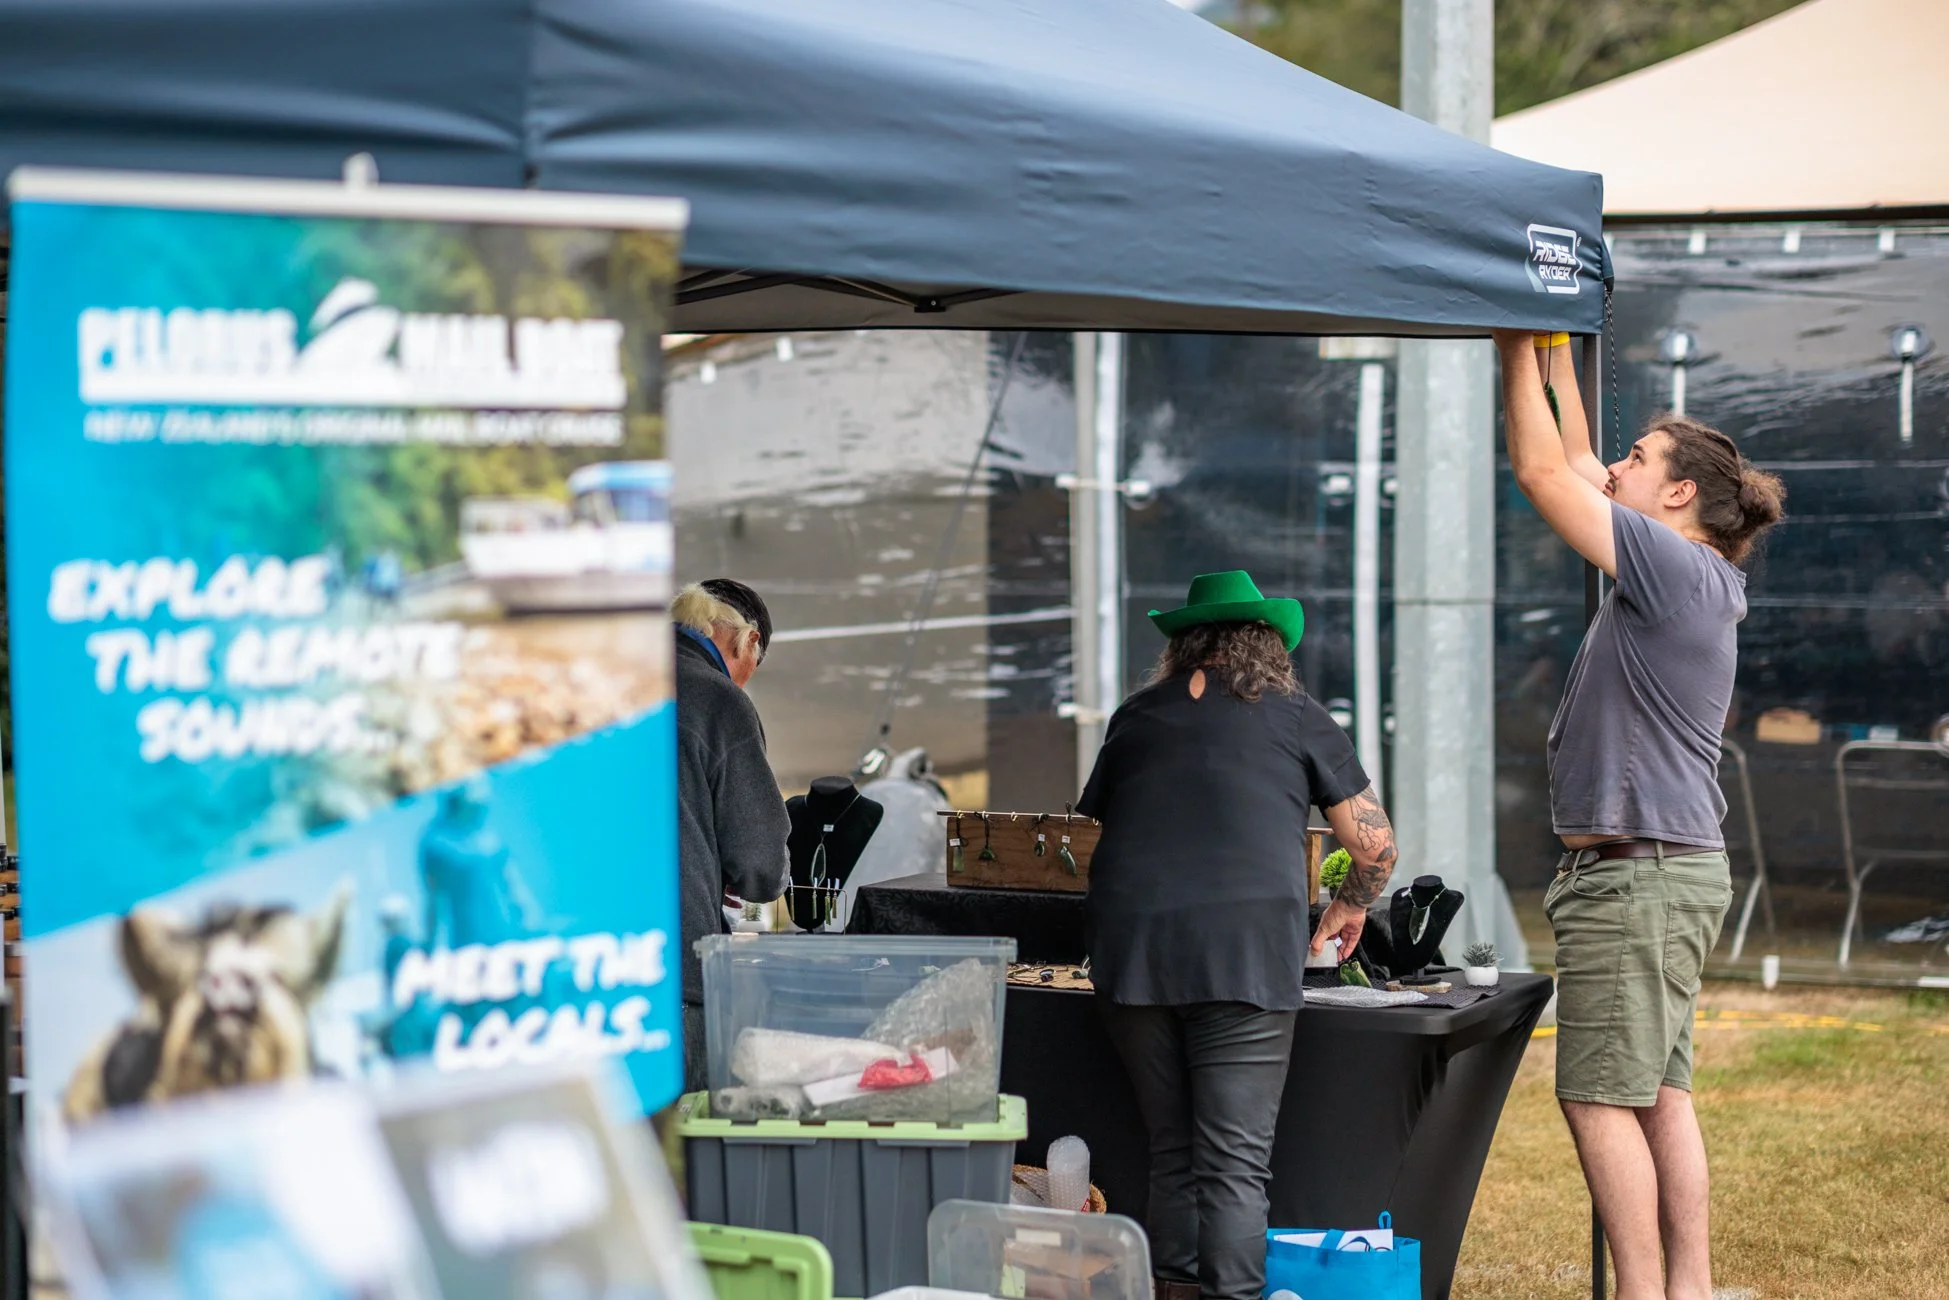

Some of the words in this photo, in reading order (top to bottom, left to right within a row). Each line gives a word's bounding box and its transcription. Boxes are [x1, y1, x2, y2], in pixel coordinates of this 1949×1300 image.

[1539, 264, 1571, 280] RYDER
[48, 557, 332, 623] EXPLORE
[87, 628, 215, 693] THE
[227, 621, 464, 686] REMOTE
[394, 935, 564, 1008] MEET
[568, 928, 667, 991] THE
